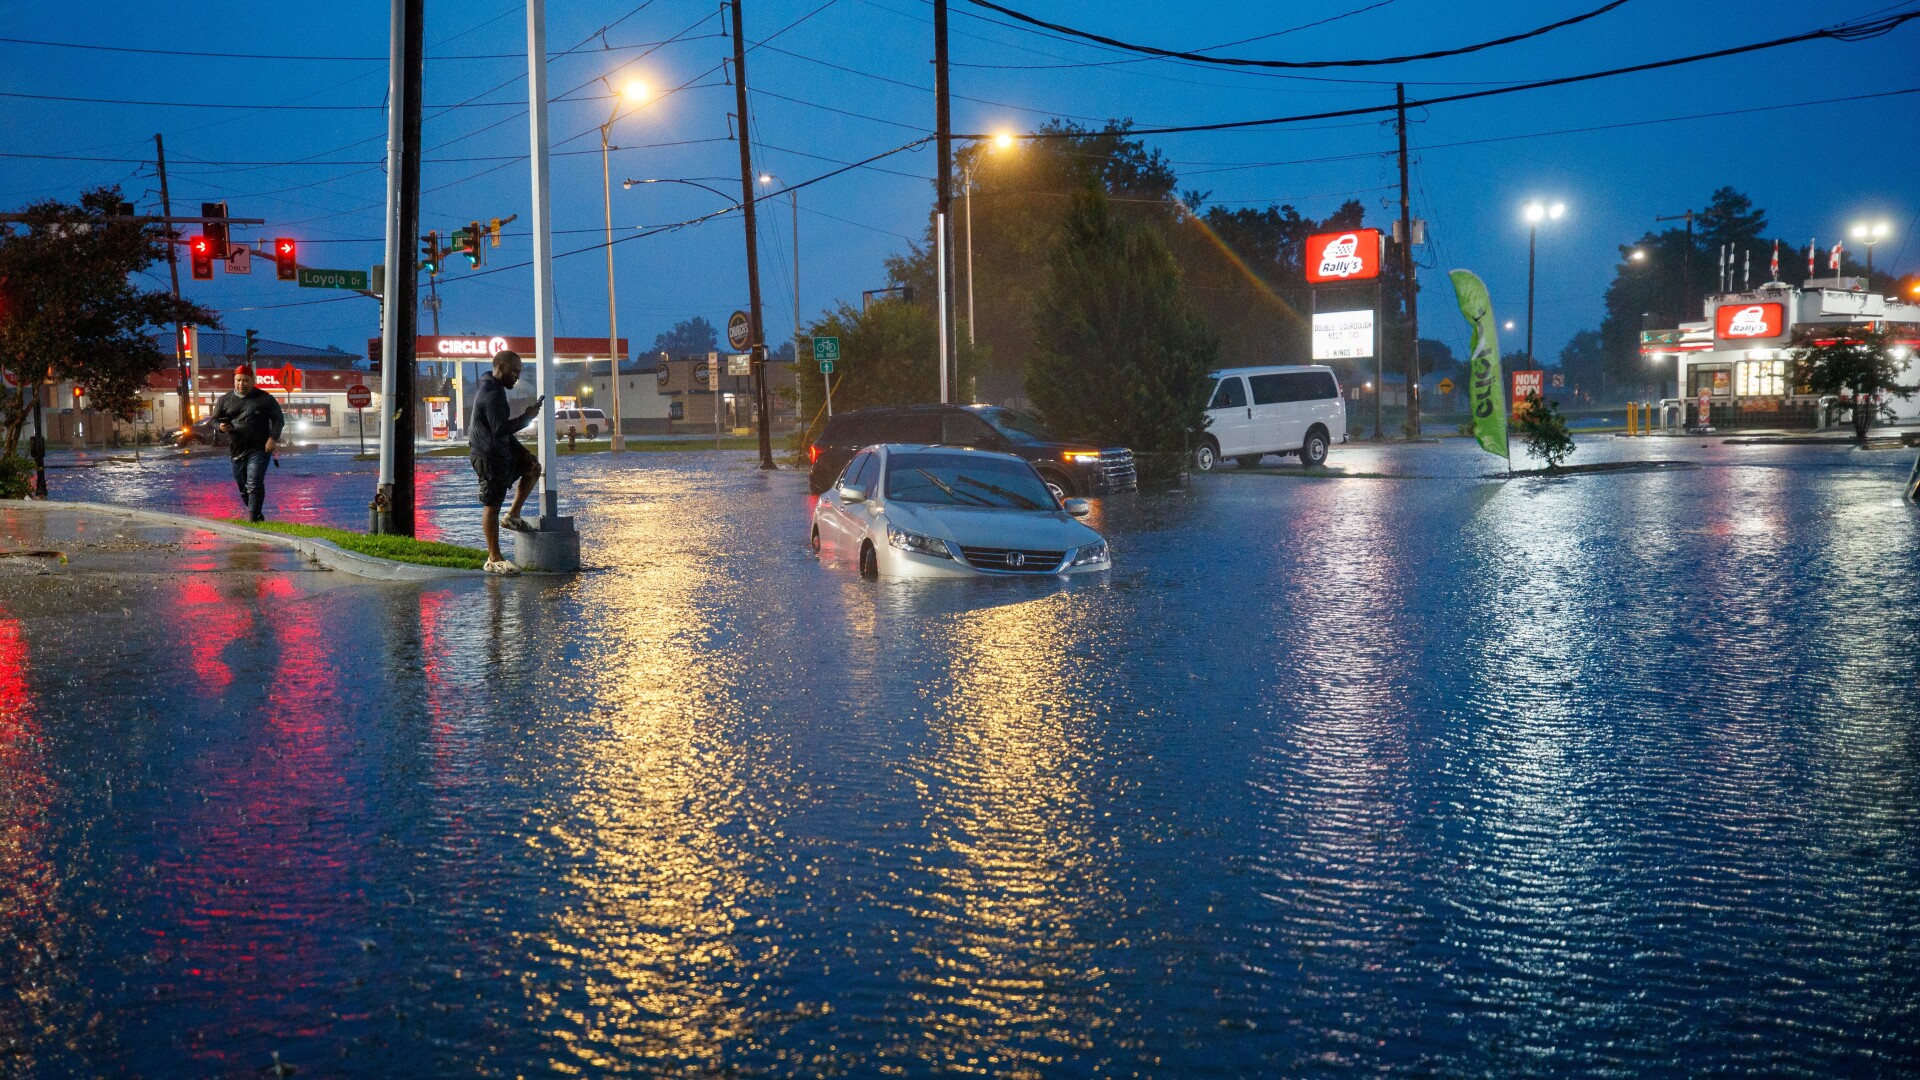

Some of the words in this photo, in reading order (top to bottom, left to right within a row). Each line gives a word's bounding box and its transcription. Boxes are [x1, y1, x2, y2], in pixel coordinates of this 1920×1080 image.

[1322, 260, 1359, 273] Rally's
[305, 272, 346, 286] Loyola
[1732, 324, 1764, 332] Rally's
[438, 340, 488, 354] CIRCLE
[1515, 374, 1540, 385] NOW
